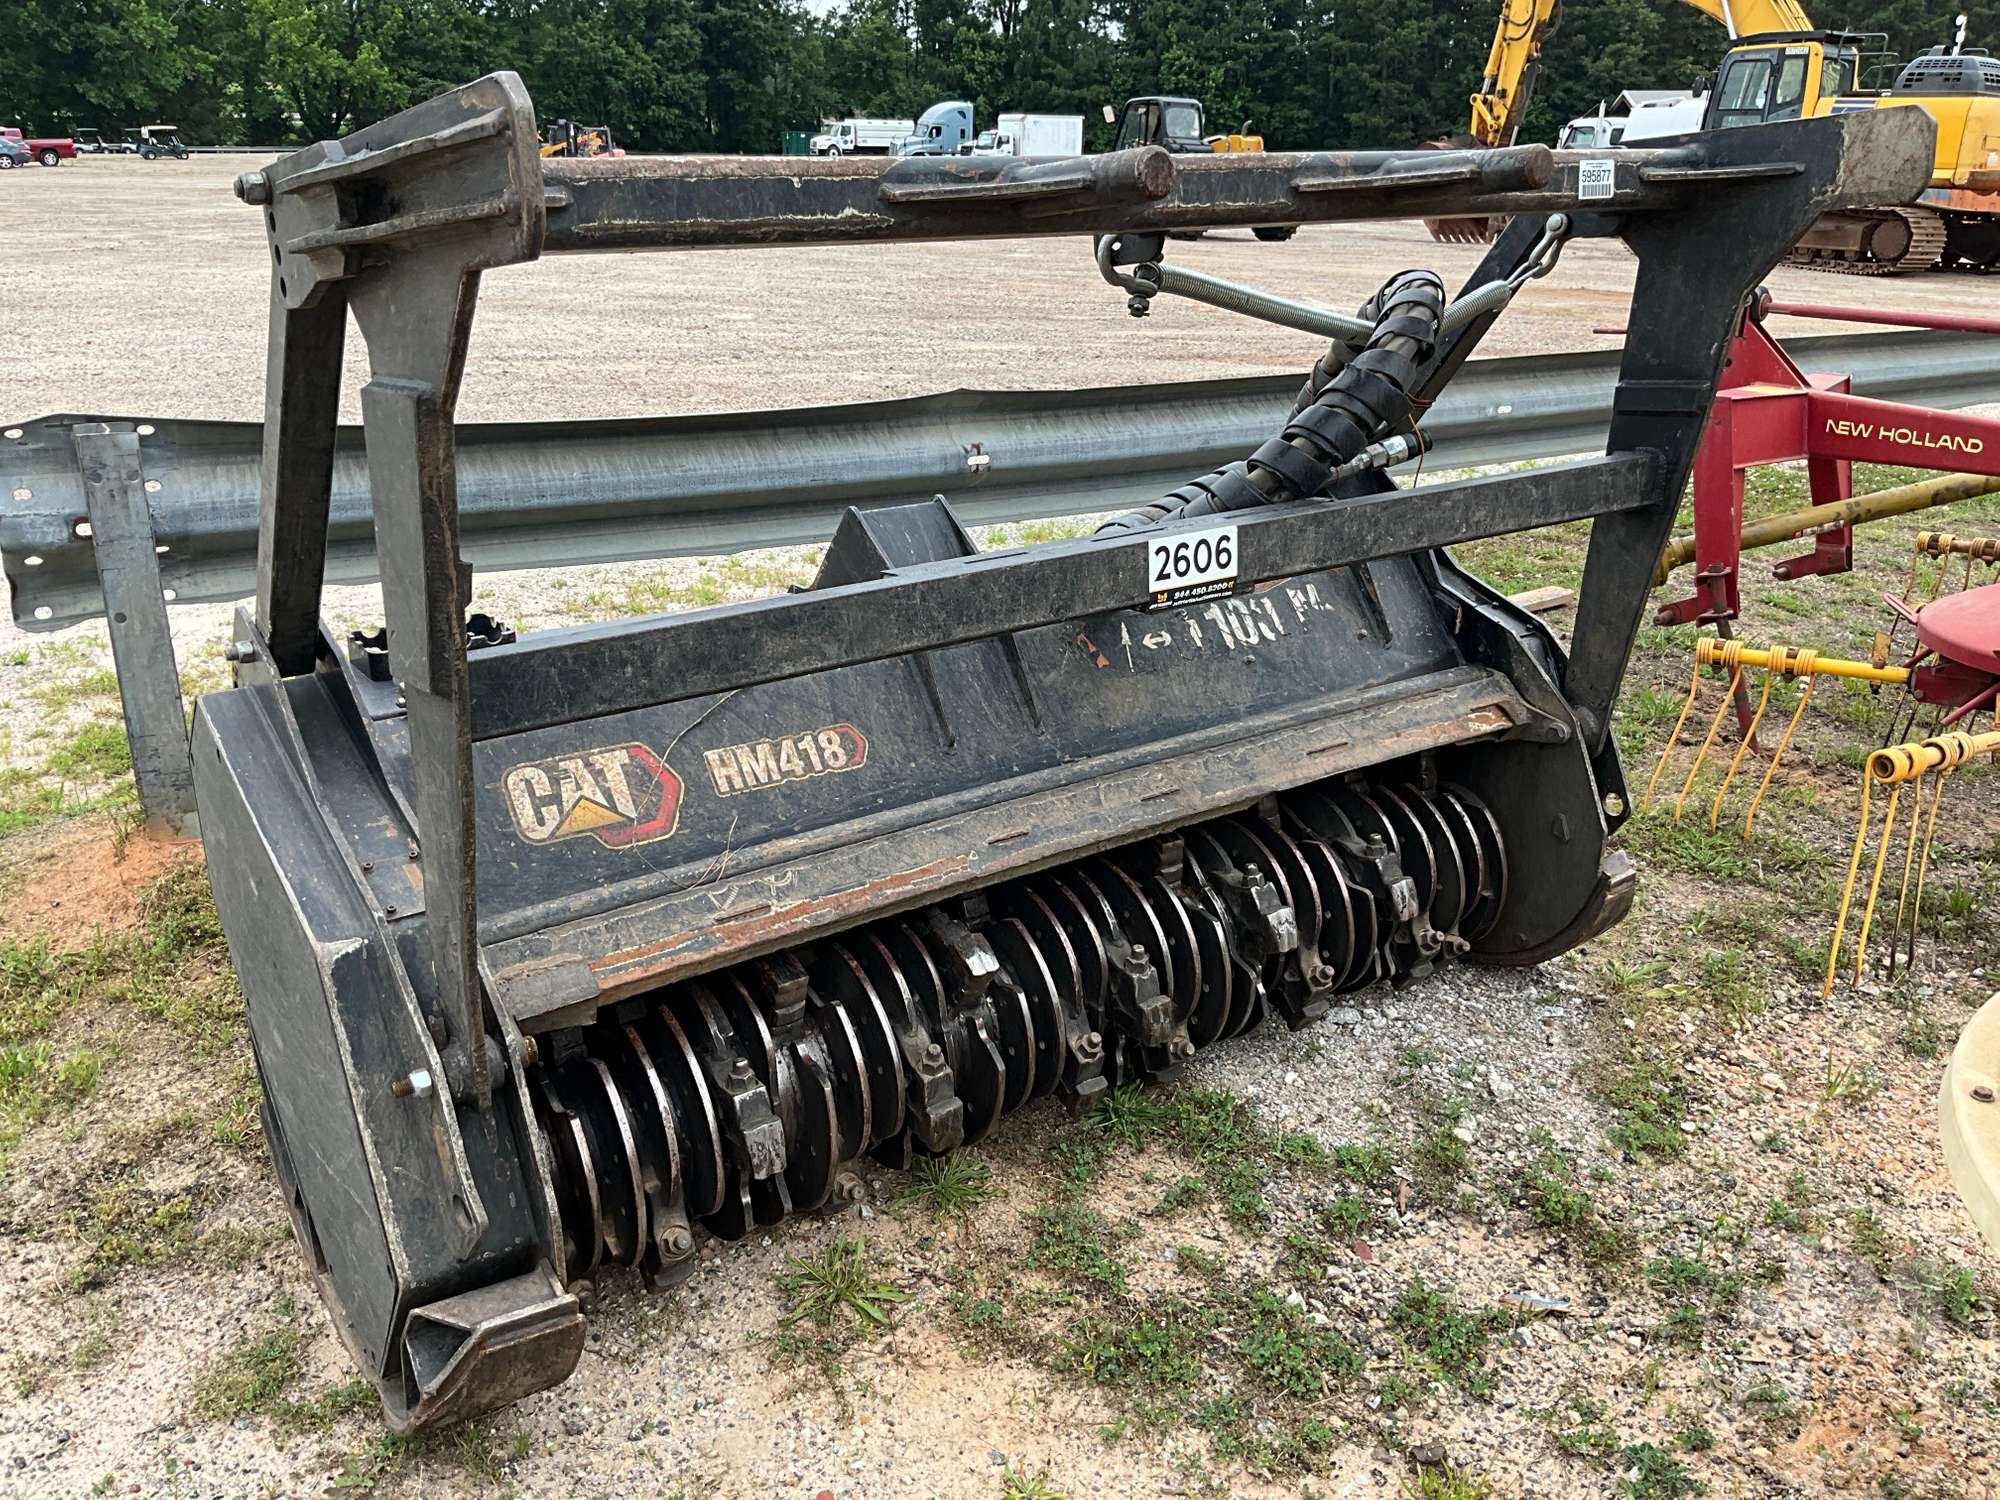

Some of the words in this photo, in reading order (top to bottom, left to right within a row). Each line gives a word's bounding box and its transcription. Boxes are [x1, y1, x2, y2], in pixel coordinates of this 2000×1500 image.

[1581, 169, 1611, 183] 595877
[1826, 419, 1873, 438] NEW
[1878, 426, 1983, 453] HOLLAND
[1154, 534, 1232, 582] 2606
[704, 730, 850, 794] HM418
[506, 749, 637, 840] CAT
